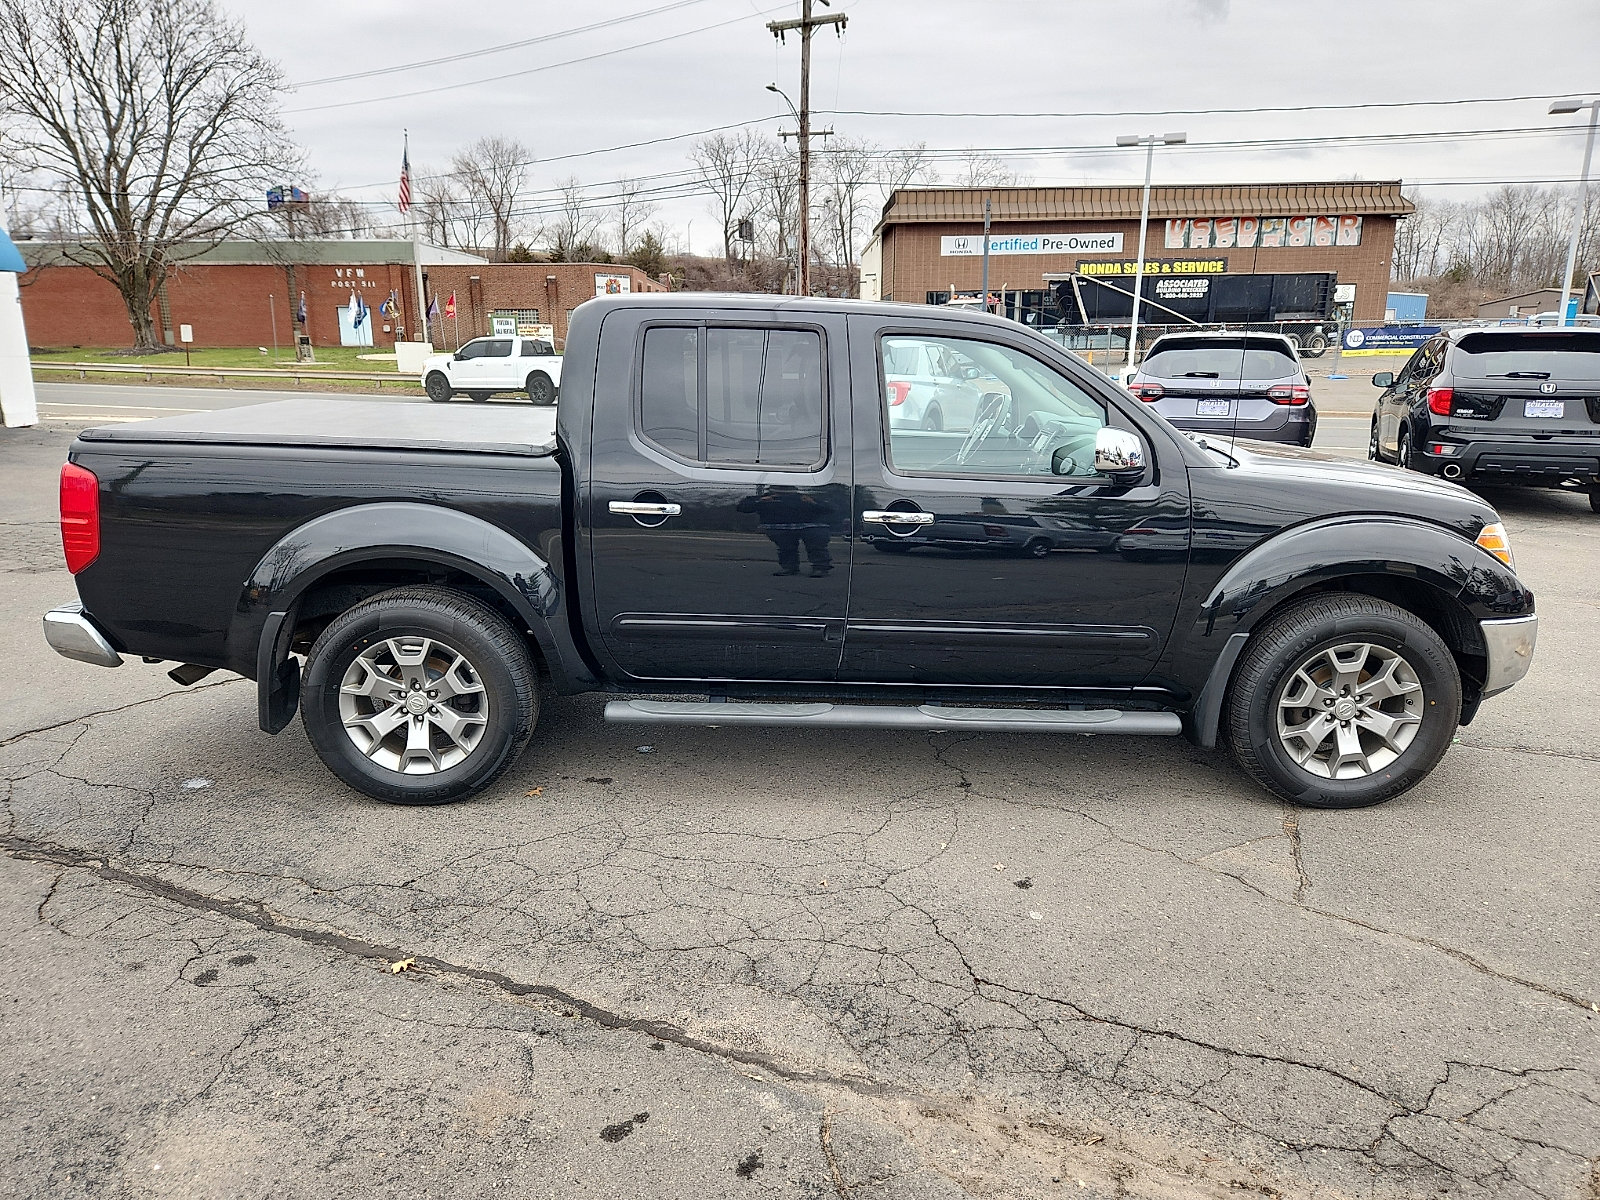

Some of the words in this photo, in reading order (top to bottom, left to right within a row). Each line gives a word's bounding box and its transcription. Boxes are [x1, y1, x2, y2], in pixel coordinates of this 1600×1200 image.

[1169, 216, 1259, 236] USED
[1289, 215, 1358, 234] CAR
[1042, 236, 1115, 250] Pre-Owned
[335, 268, 365, 278] VFW
[1080, 263, 1122, 275] HONDA
[1161, 262, 1172, 273] &
[1173, 261, 1224, 273] SERVICE
[331, 280, 356, 288] POST
[361, 280, 376, 288] 511
[1156, 279, 1209, 288] ASSOCIATED
